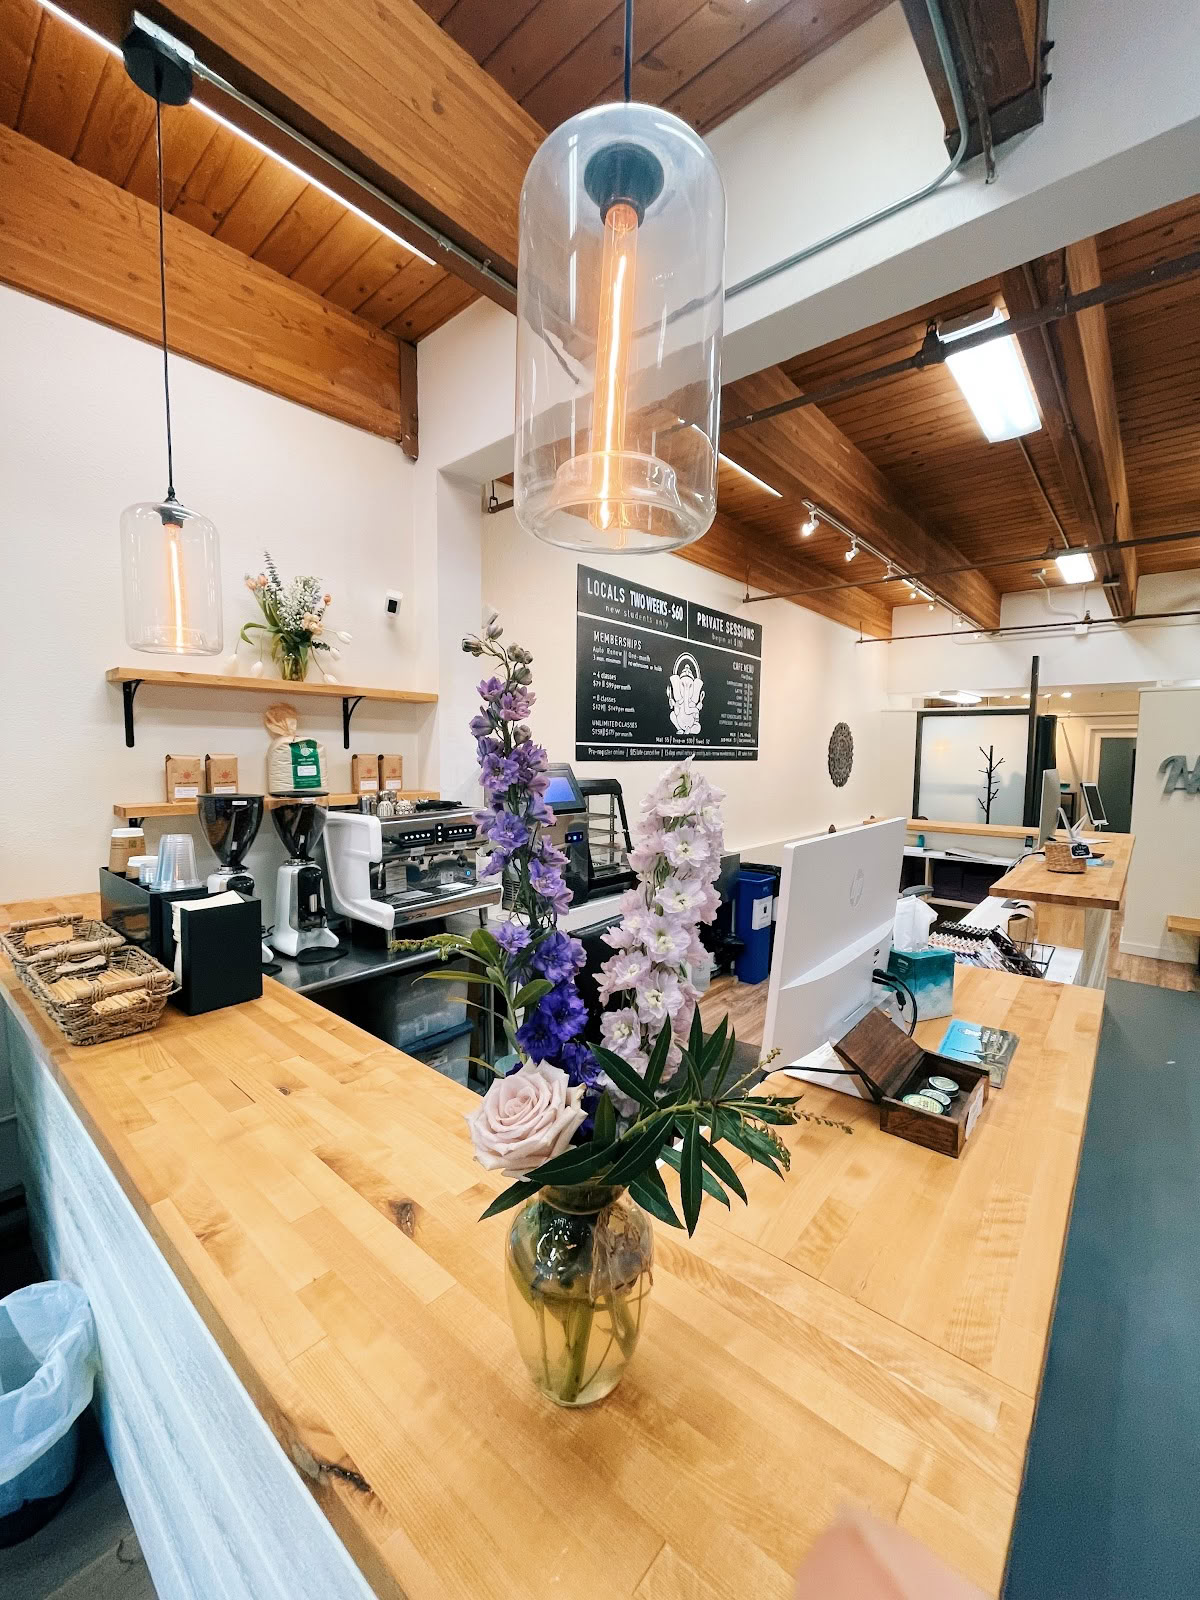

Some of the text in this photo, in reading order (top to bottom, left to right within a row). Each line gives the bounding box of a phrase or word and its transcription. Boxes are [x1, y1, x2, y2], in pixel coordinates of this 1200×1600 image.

[587, 577, 625, 603] LOCALS
[629, 590, 645, 610] TWO
[646, 595, 668, 616] WEEKS
[671, 603, 684, 621] $60
[605, 605, 621, 614] new
[623, 610, 653, 623] students
[697, 611, 755, 641] PRIVATE SESSIONS
[593, 630, 642, 650] MEMBERSHIPS
[606, 648, 622, 656] Renew
[601, 672, 616, 680] classes
[600, 695, 616, 703] classes
